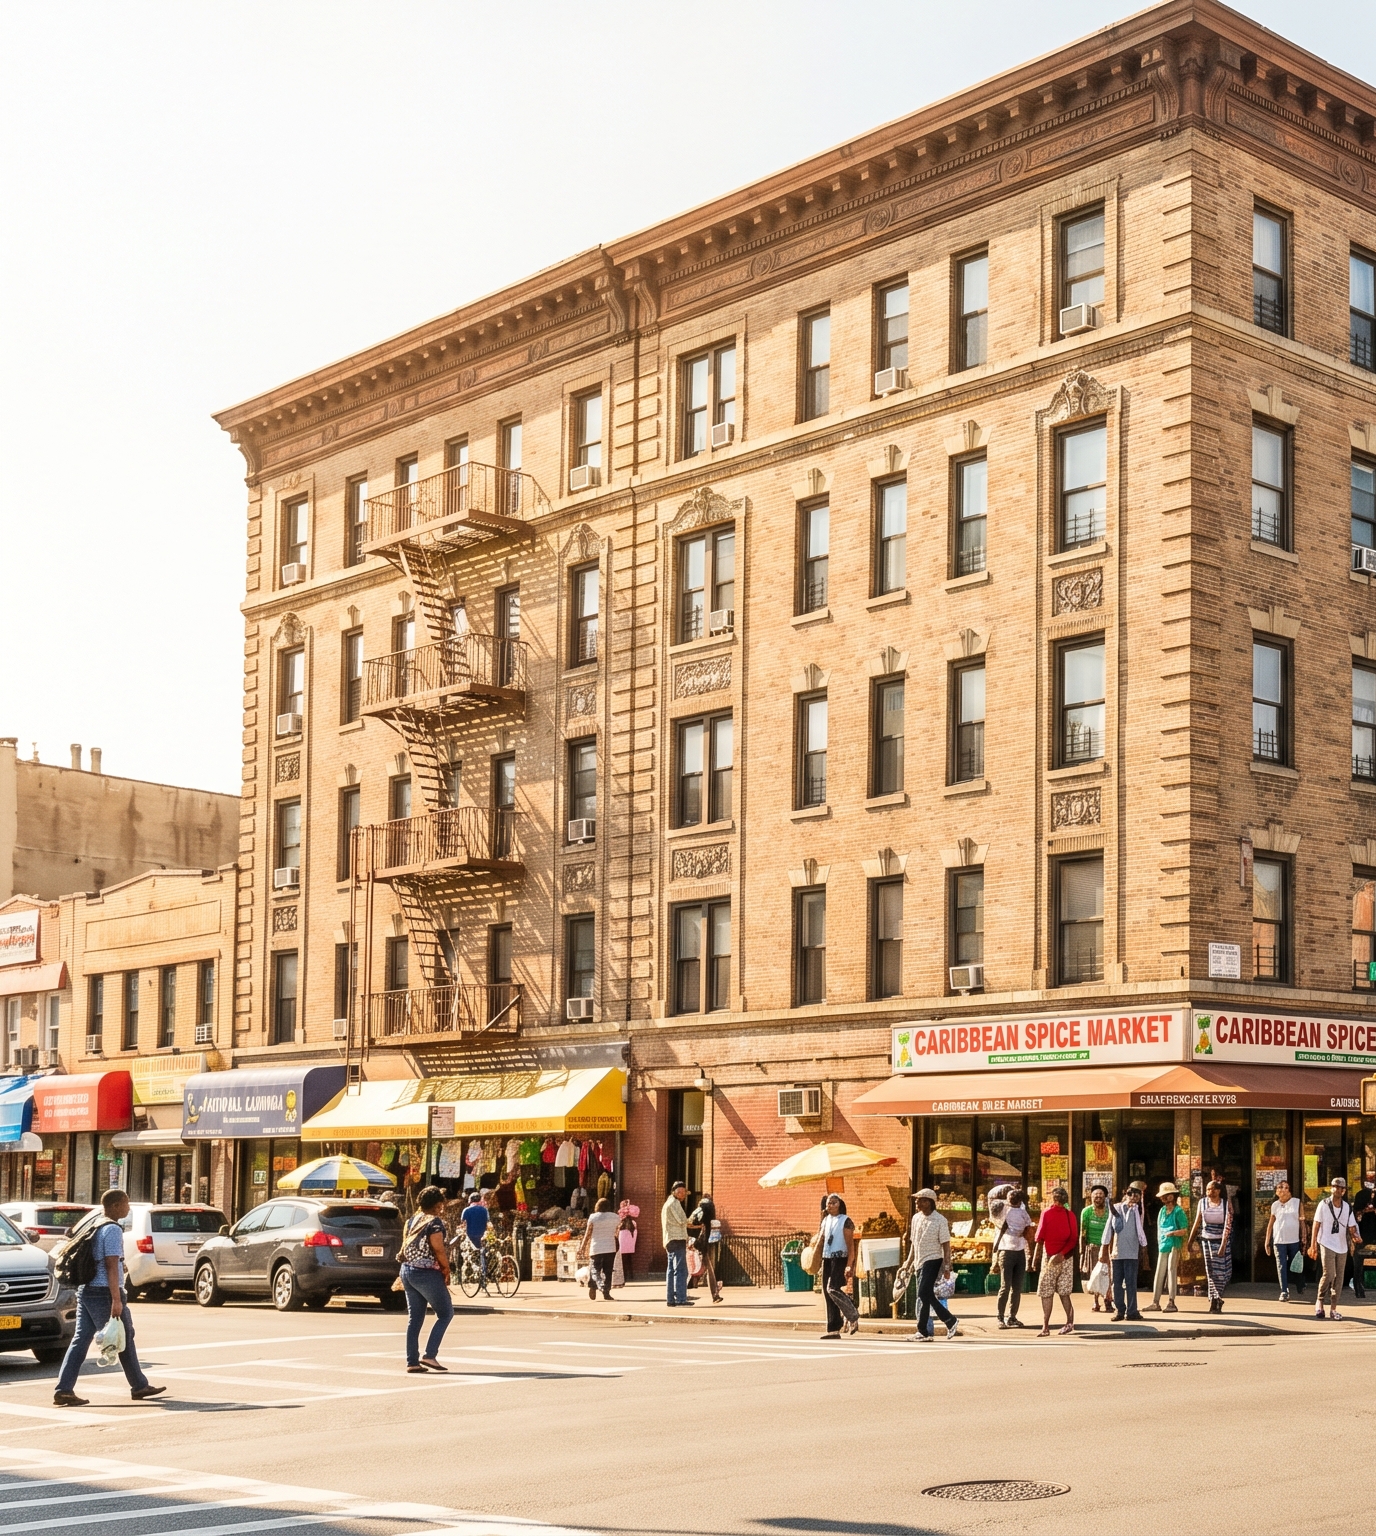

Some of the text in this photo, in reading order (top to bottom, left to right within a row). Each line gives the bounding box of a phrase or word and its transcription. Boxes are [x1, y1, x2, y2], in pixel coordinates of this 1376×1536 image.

[915, 1015, 1172, 1056] CARIBBEAN SPICE MARKET
[1216, 1015, 1321, 1048] CARIBBEAN
[1326, 1023, 1376, 1051] SPICE
